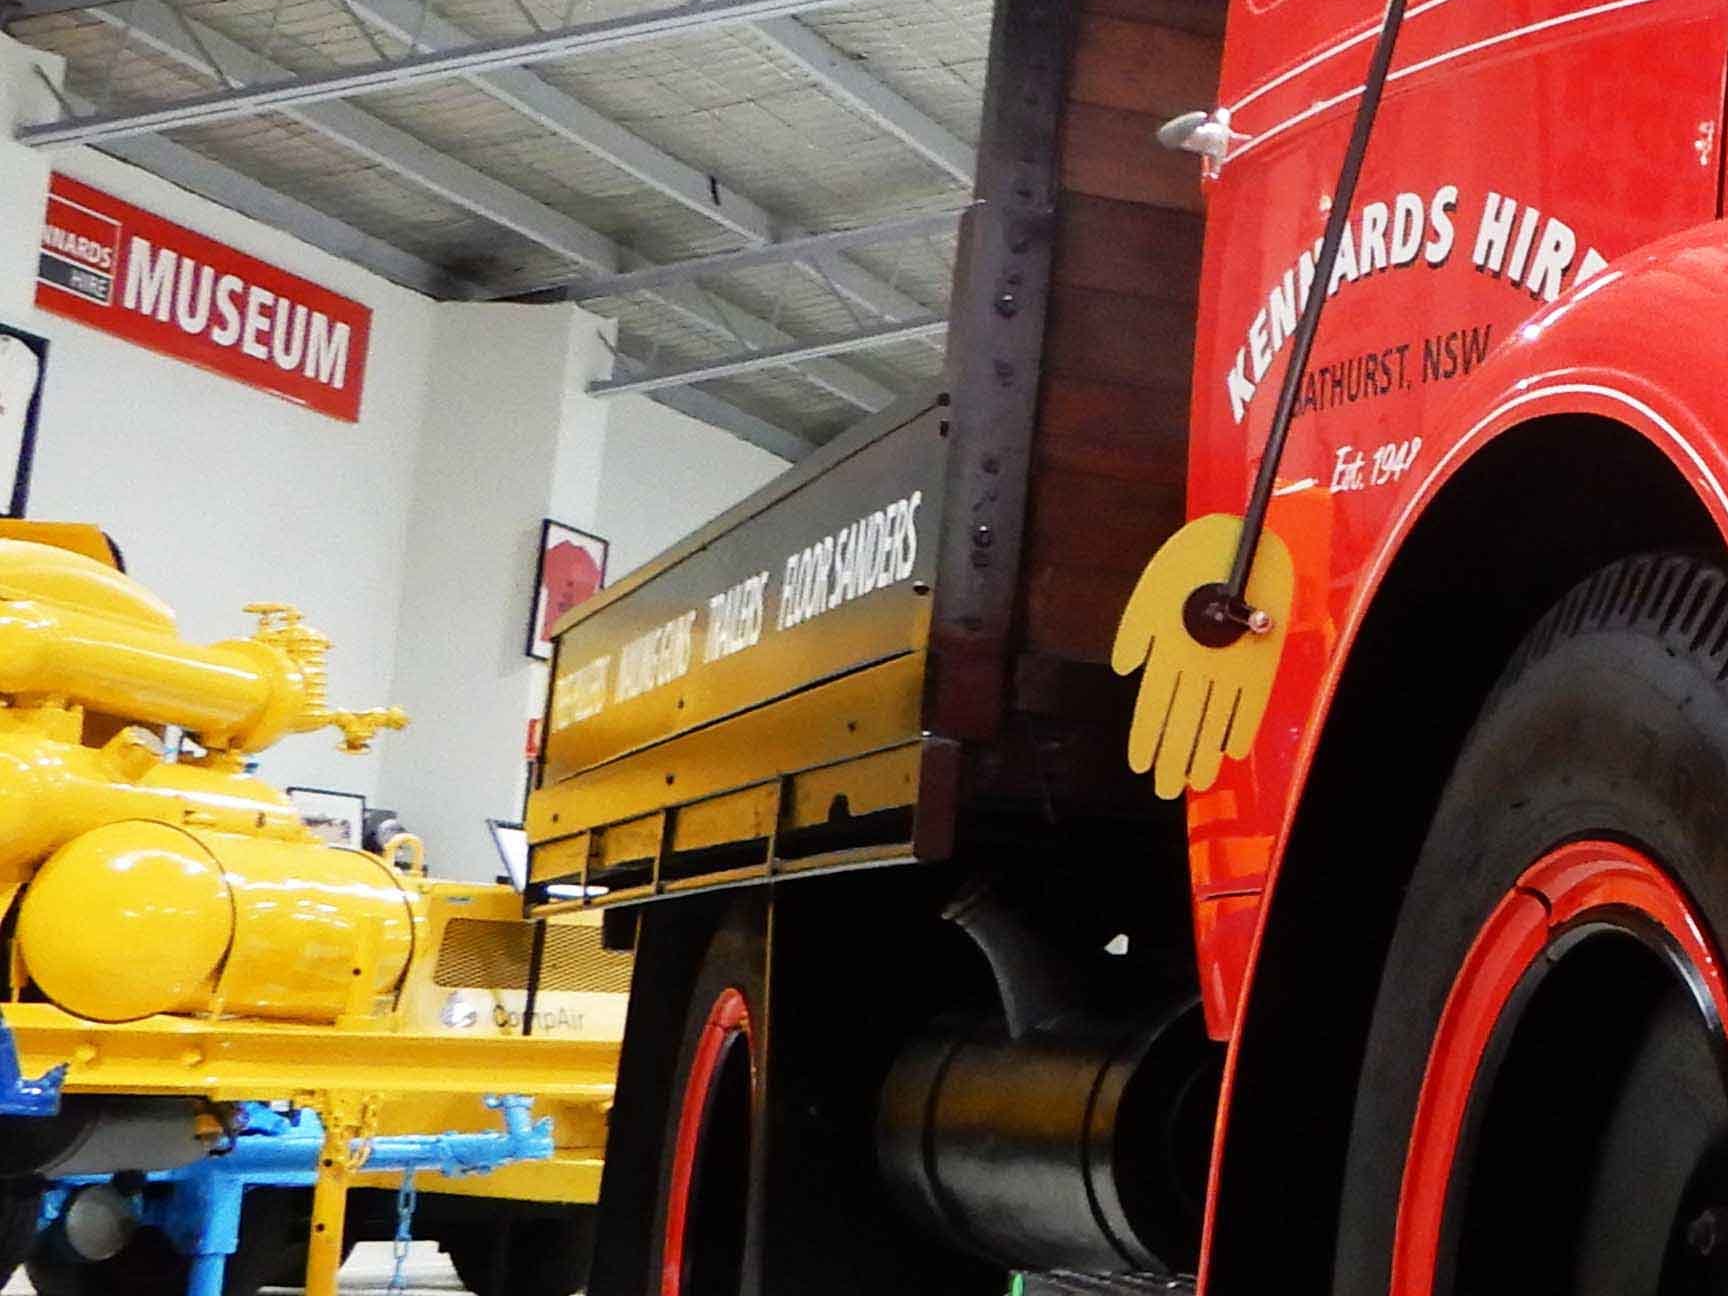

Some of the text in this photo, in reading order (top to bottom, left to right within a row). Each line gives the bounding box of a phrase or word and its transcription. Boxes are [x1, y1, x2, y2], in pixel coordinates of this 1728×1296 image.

[122, 235, 350, 390] MUSEUM
[1292, 324, 1492, 417] ATHURST, NSW
[827, 491, 921, 609] SANDERS
